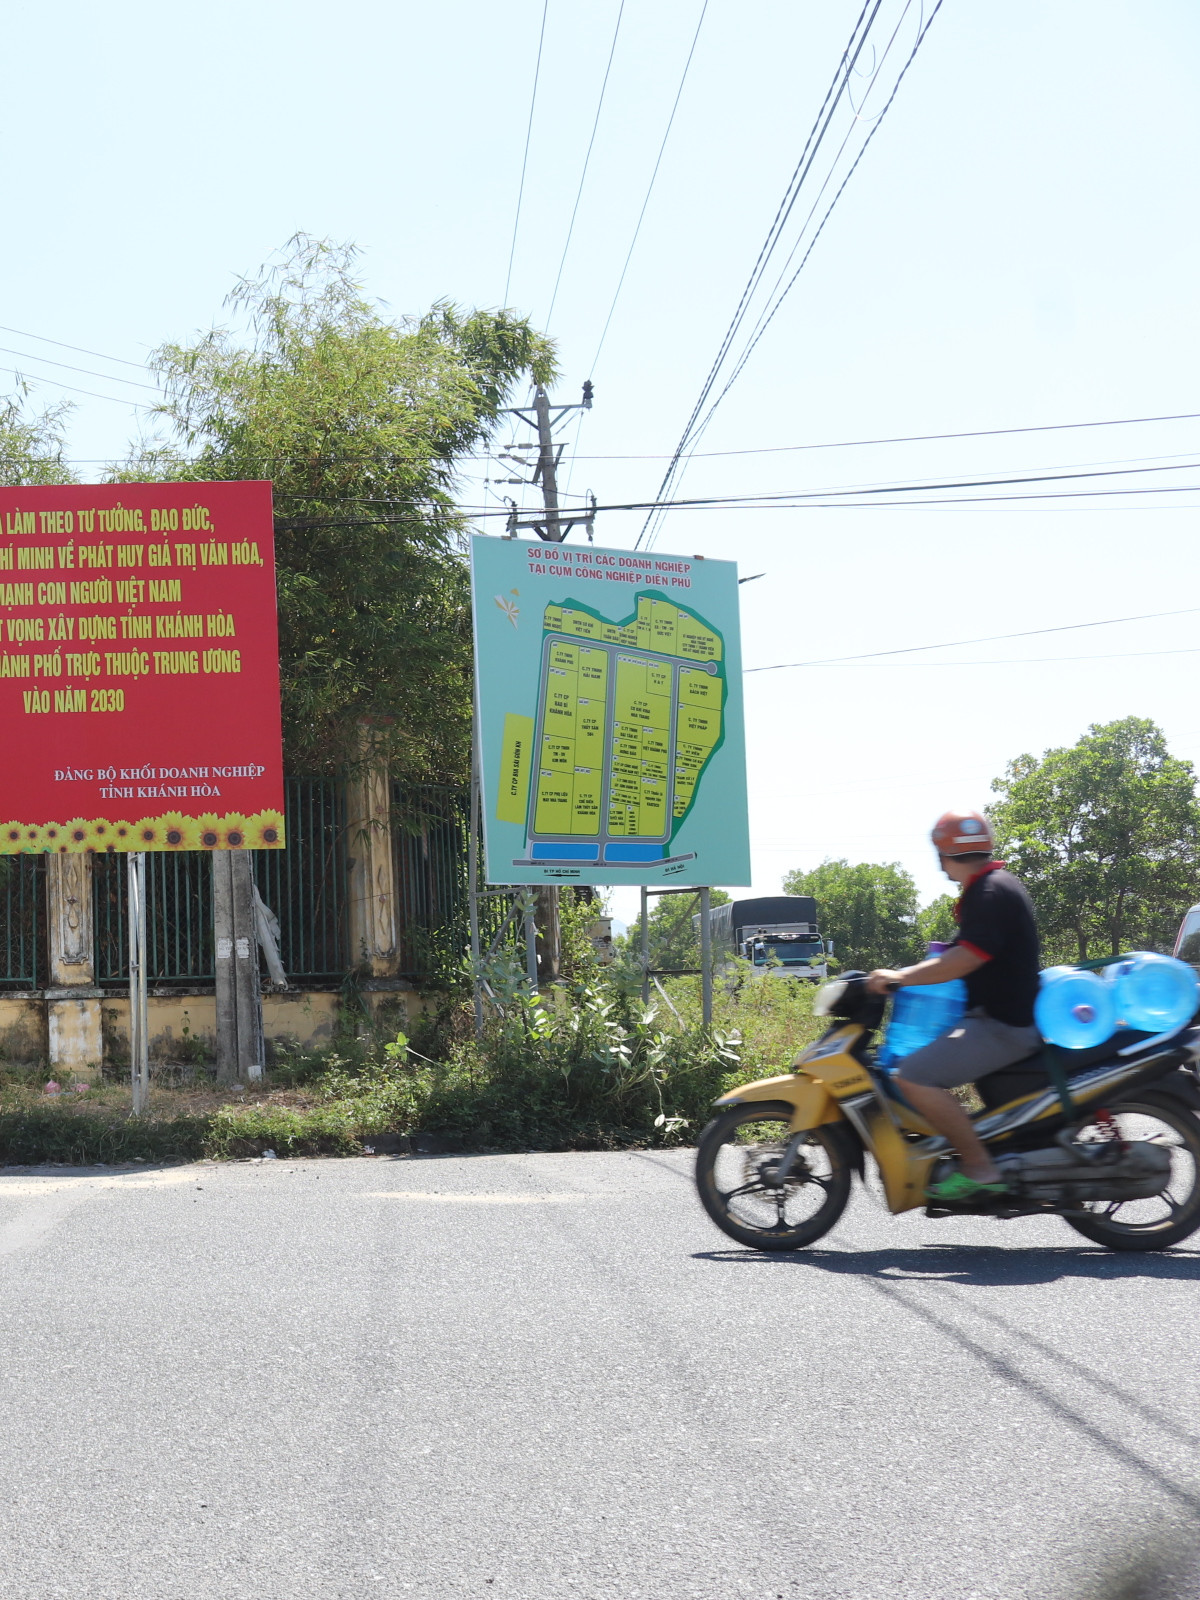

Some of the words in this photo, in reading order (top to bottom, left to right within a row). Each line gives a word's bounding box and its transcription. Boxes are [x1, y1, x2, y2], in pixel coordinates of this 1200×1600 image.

[7, 508, 35, 534] LÀM
[40, 511, 73, 533] THEO
[77, 508, 95, 532] TƯ
[98, 502, 147, 533] TƯỞNG,
[151, 509, 178, 536] ĐẠO
[182, 504, 214, 532] ĐỨC,
[18, 547, 54, 569] MINH
[58, 540, 74, 568] VỀ
[79, 541, 113, 568] PHÁT
[118, 545, 144, 567] HUY
[148, 540, 171, 566] GIÁ
[175, 544, 196, 570] TRỊ
[200, 539, 228, 565] VĂN
[232, 538, 263, 567] HÓA,
[528, 548, 542, 558] SƠ
[545, 547, 559, 560] ĐỒ
[562, 552, 572, 563] VỊ
[576, 552, 593, 564] TRÍ
[596, 554, 615, 566] CÁC
[619, 558, 651, 569] DOANH
[655, 561, 690, 573] NGHIỆP
[528, 563, 545, 575] TẠI
[550, 565, 572, 578] CỤM
[575, 566, 602, 579] CÔNG
[606, 571, 642, 583] NGHIỆP
[672, 577, 691, 588] PHÚ
[38, 582, 66, 604] CON
[70, 576, 112, 604] NGƯỜI
[116, 580, 144, 607] VIỆT
[149, 580, 181, 602] NAM
[7, 618, 44, 646] VỌNG
[48, 614, 74, 640] XÂY
[79, 615, 116, 644] DỰNG
[120, 609, 152, 638] TỈNH
[156, 611, 203, 638] KHÁNH
[207, 609, 235, 637] HÒA
[34, 646, 61, 676] PHỐ
[66, 651, 100, 680] TRỰC
[104, 648, 149, 680] THUỘC
[153, 651, 198, 674] TRUNG
[203, 648, 240, 673] ƯƠNG
[23, 686, 50, 713] VÀO
[55, 686, 86, 712] NĂM
[91, 689, 124, 712] 2030
[54, 766, 94, 781] ĐẢNG
[97, 765, 116, 783] BỘ
[119, 762, 155, 780] KHỐI
[159, 766, 208, 779] DOANH
[211, 762, 265, 780] NGHIỆP
[99, 783, 133, 799] TỈNH
[137, 783, 187, 798] KHÁNH
[190, 782, 220, 797] HÒA
